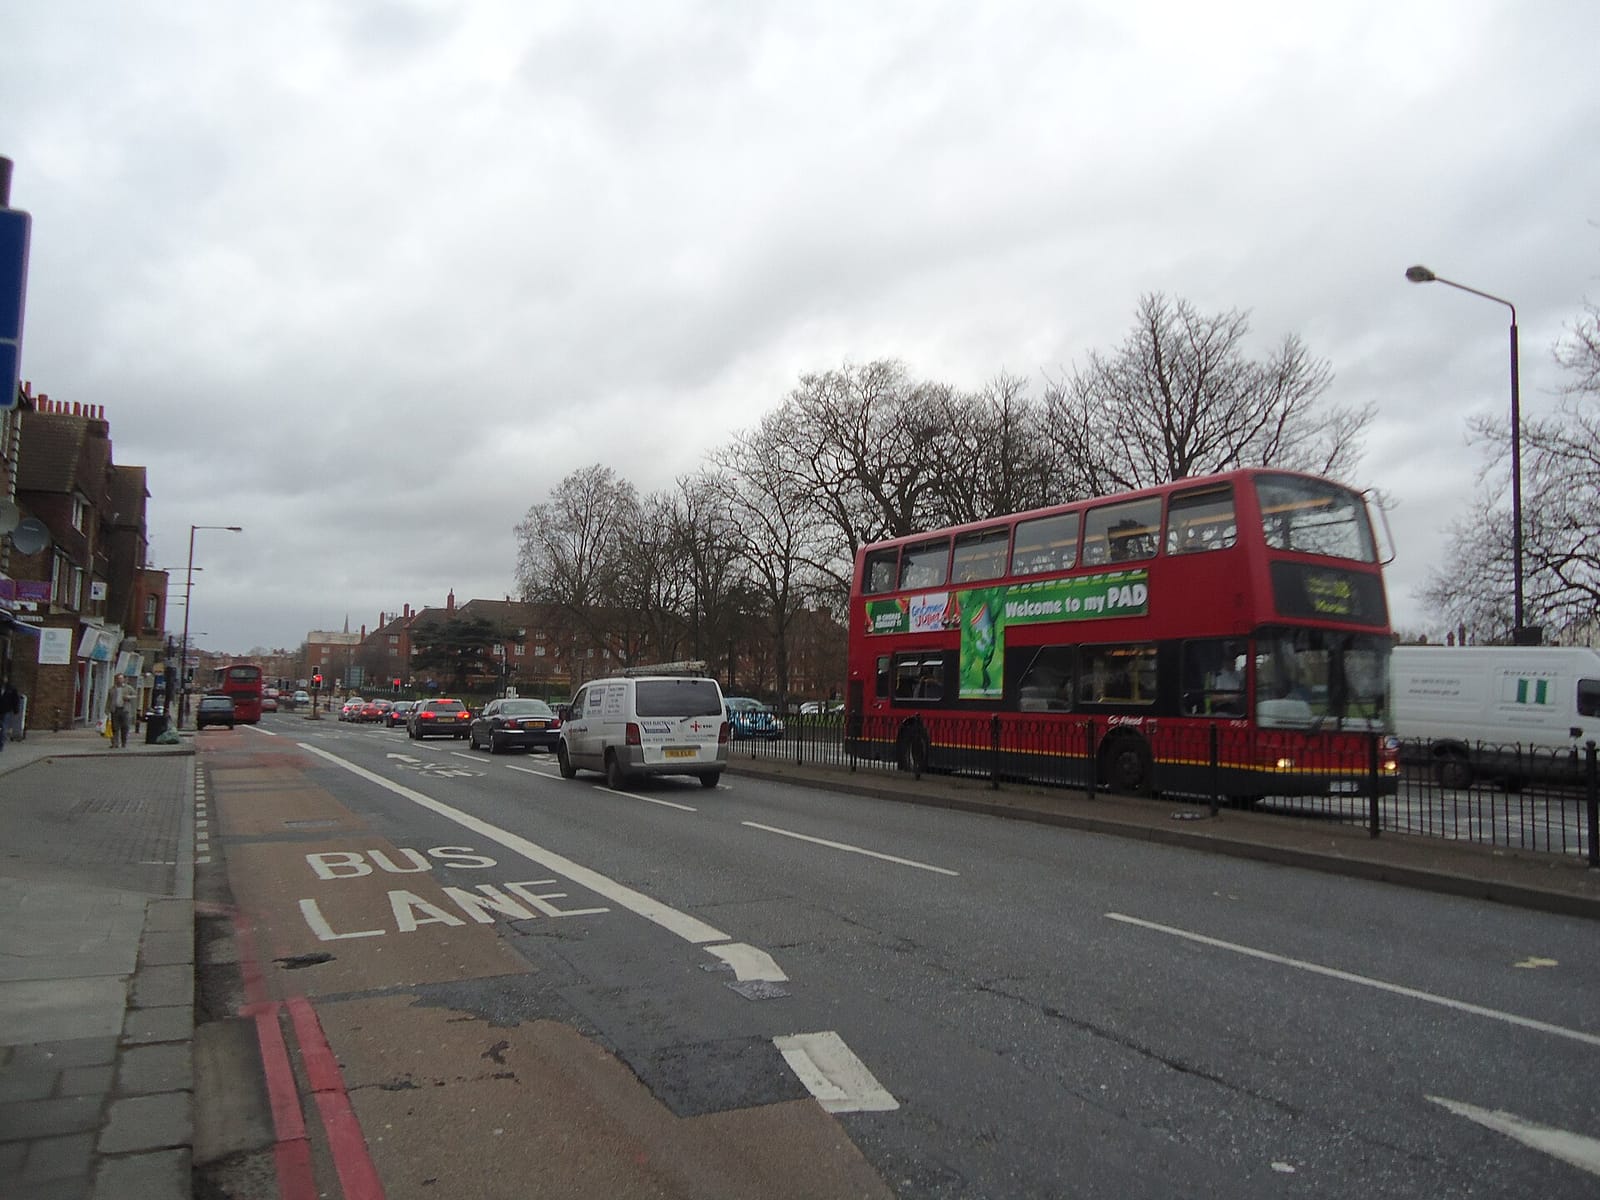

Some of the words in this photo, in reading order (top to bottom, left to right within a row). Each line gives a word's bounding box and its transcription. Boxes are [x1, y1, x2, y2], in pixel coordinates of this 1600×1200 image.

[1005, 599, 1063, 618] Welcome
[1065, 596, 1081, 613] to
[1084, 595, 1105, 613] my
[1107, 583, 1148, 609] PAD
[305, 845, 498, 881] BUS
[298, 879, 611, 941] LANE
